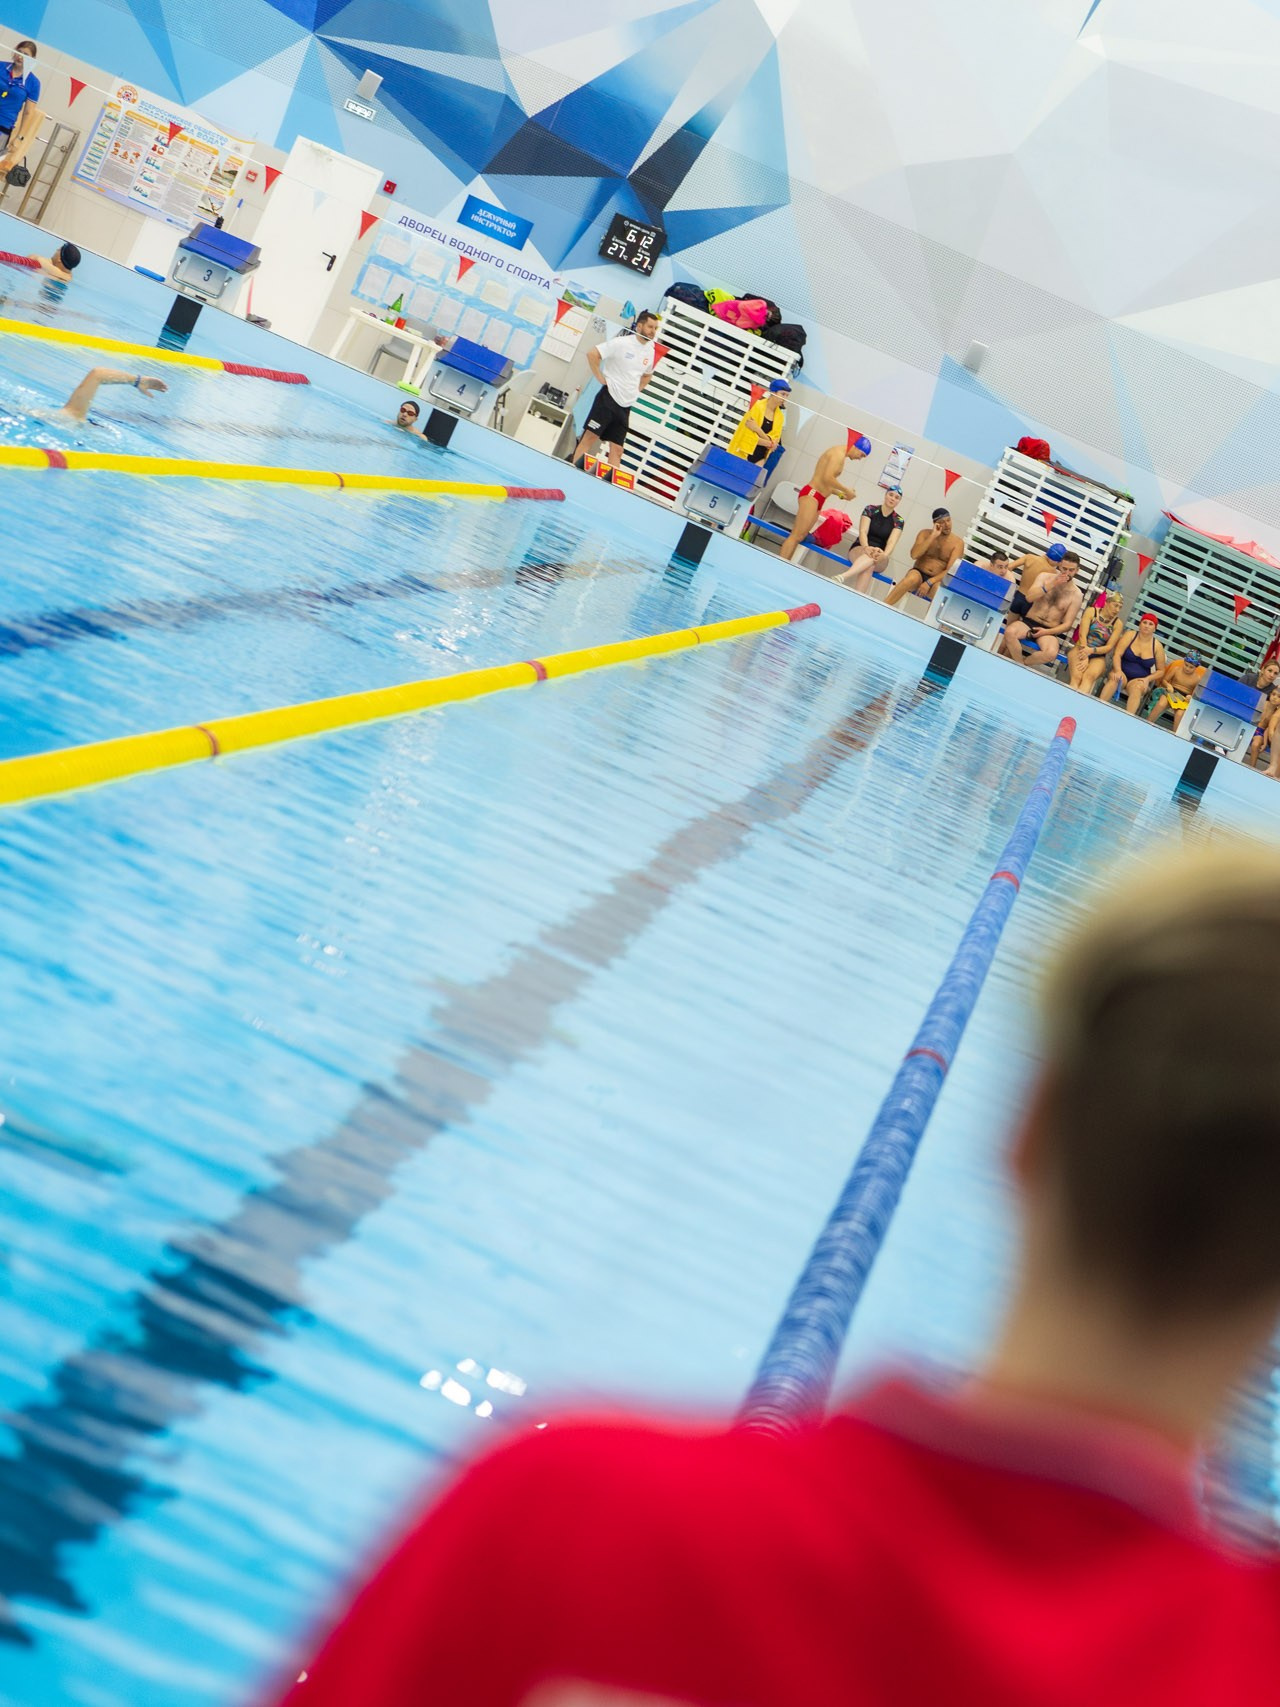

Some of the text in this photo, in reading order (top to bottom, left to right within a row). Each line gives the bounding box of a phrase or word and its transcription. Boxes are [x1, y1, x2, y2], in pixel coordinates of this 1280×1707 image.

[471, 213, 517, 238] ИНСТРУКТОР
[477, 208, 516, 230] ДЕЖУРНЫЙ
[398, 215, 550, 290] ДВОРЕЦ ВОДНОГО СПОРТА
[203, 269, 213, 282] 3
[457, 384, 467, 396] 4
[709, 496, 719, 509] 5
[961, 608, 971, 621] 6
[1214, 720, 1223, 733] 7
